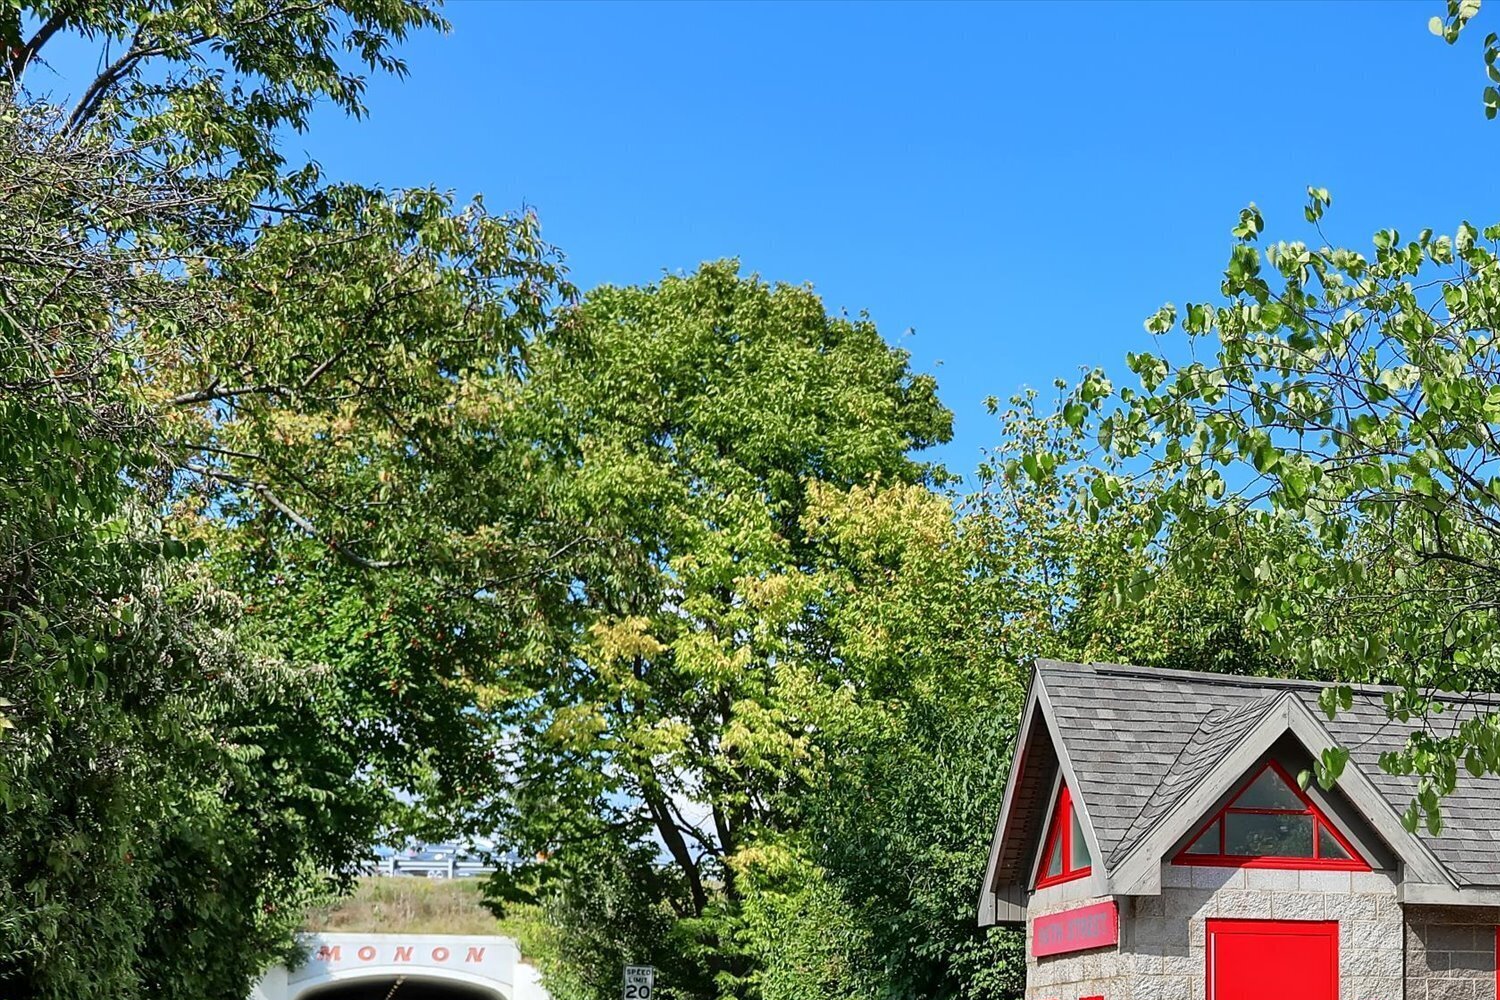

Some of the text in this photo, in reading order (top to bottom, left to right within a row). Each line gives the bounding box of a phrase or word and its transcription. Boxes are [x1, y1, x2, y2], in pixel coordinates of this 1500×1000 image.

[316, 945, 486, 962] MONON
[626, 968, 650, 976] SPEED
[626, 985, 650, 999] 20
